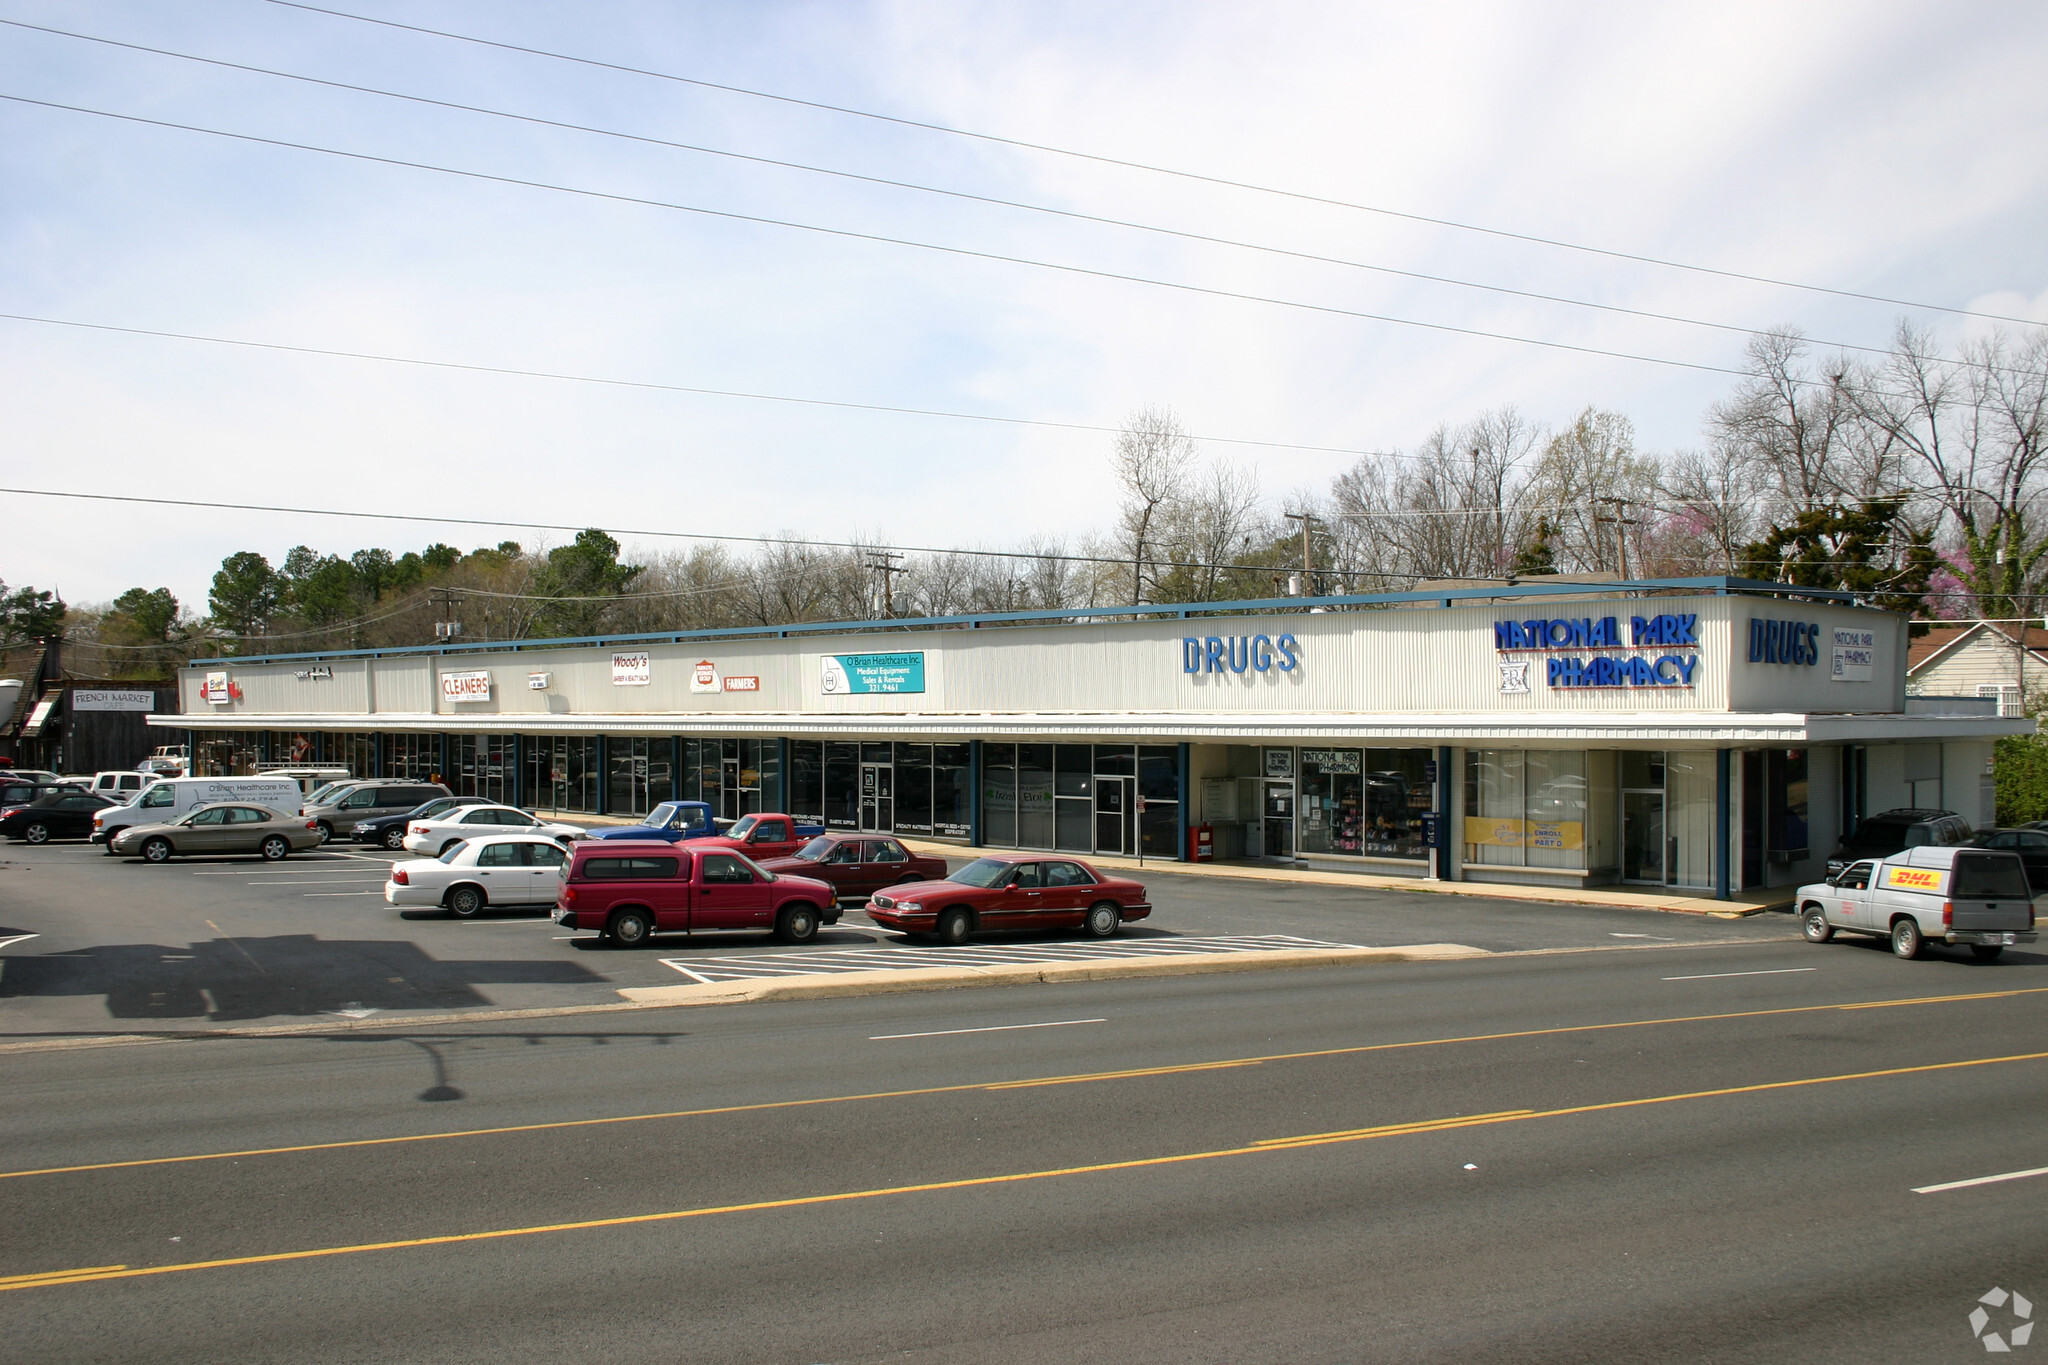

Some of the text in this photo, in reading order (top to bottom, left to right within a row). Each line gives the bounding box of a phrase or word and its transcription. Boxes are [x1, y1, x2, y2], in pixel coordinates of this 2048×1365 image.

[1494, 614, 1697, 648] NATIONAL PARK
[1748, 618, 1819, 666] DRUGS
[1834, 632, 1872, 646] NATIONAL PARK
[1183, 633, 1296, 673] DRUGS
[1845, 650, 1872, 664] PHARMACY
[613, 655, 647, 670] Woody's
[847, 655, 920, 666] O'Brian Healthcare Inc.
[856, 667, 910, 676] Medical Equipment
[1546, 655, 1697, 686] PHARMACY
[443, 677, 488, 695] CLEANERS
[726, 677, 756, 690] FARMERS
[862, 676, 876, 684] Sales
[868, 684, 898, 692] 321.9461
[76, 693, 150, 704] FRENCH MARKET
[103, 701, 125, 709] CAFE
[1302, 752, 1359, 762] NATIONAL PARK
[1319, 763, 1359, 772] PHARMACY
[209, 784, 234, 792] O'Brian
[236, 783, 277, 791] Healthcare
[1896, 872, 1932, 886] DHL
